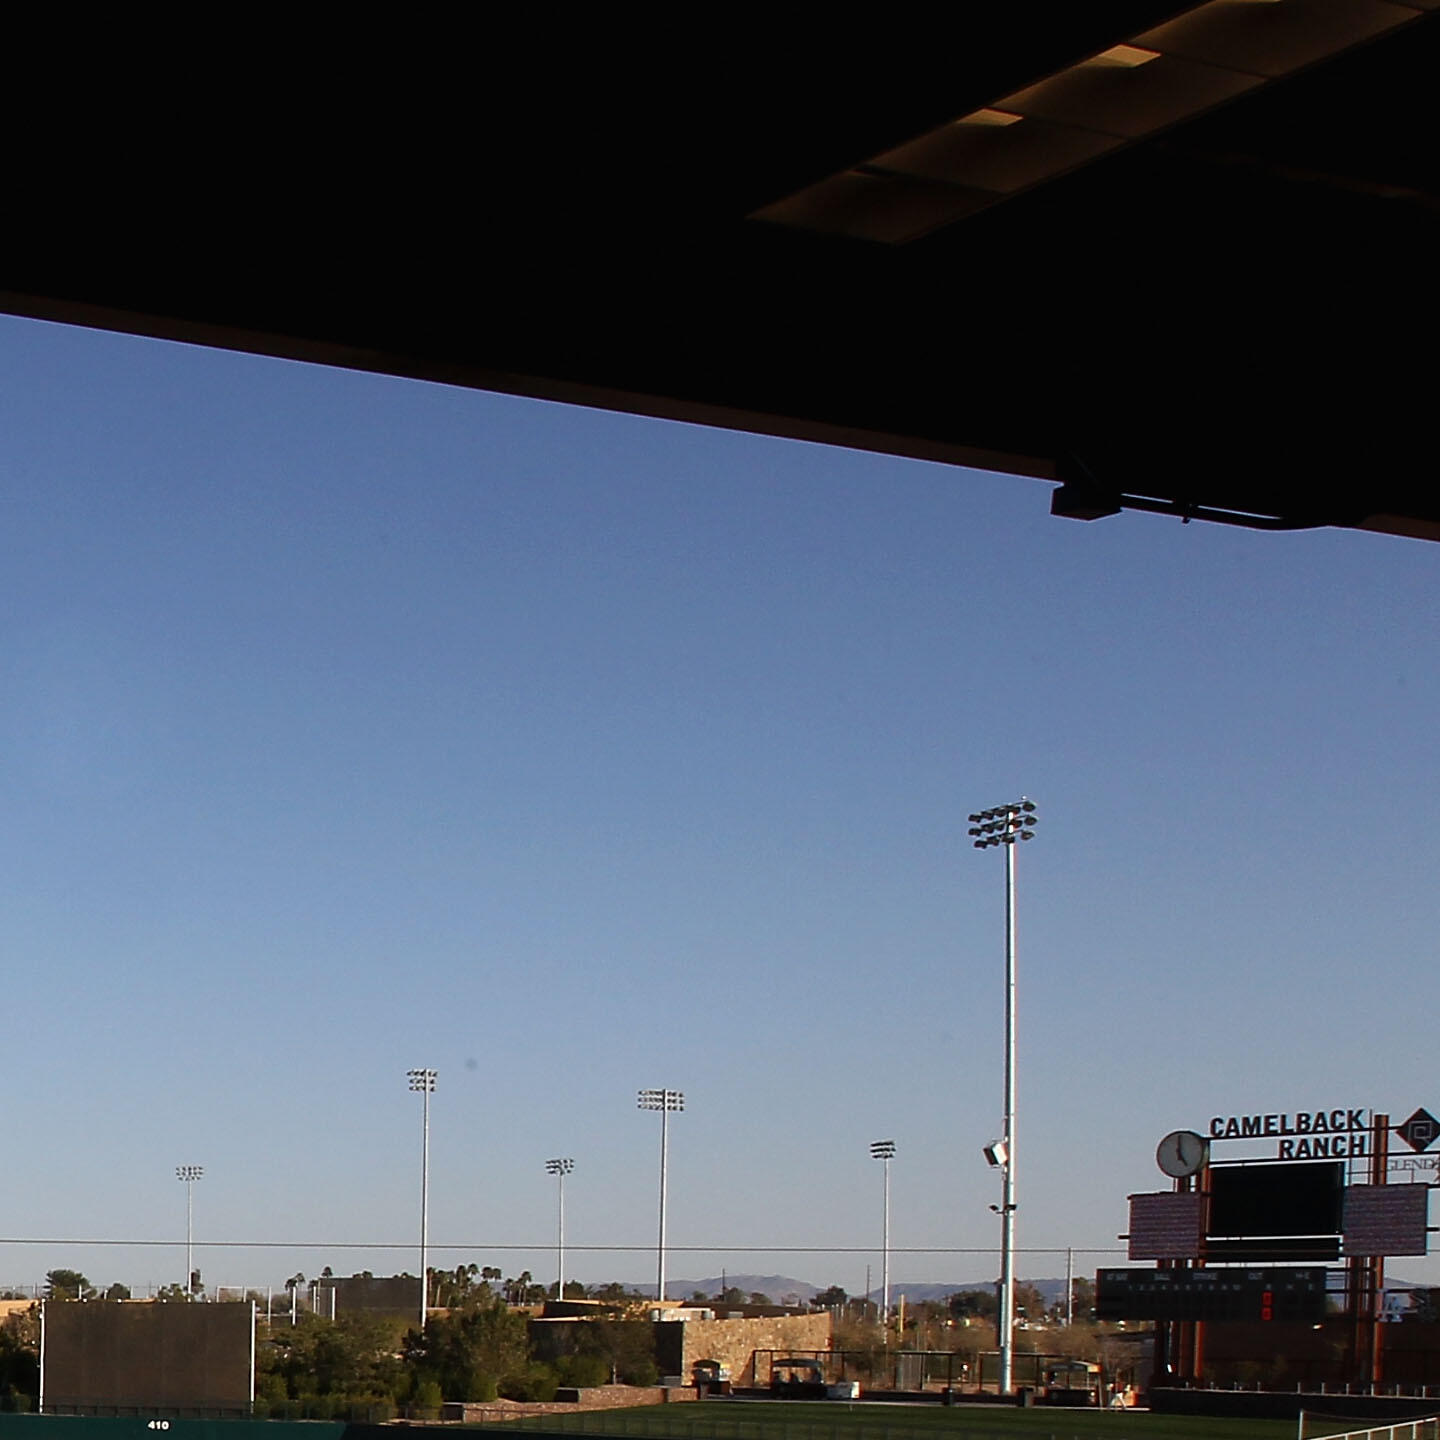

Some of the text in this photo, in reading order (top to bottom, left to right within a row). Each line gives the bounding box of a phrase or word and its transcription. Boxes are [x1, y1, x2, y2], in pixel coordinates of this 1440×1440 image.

[1210, 1109, 1365, 1137] CAMELBACK
[1279, 1136, 1365, 1158] RANCH
[147, 1420, 169, 1430] 410
